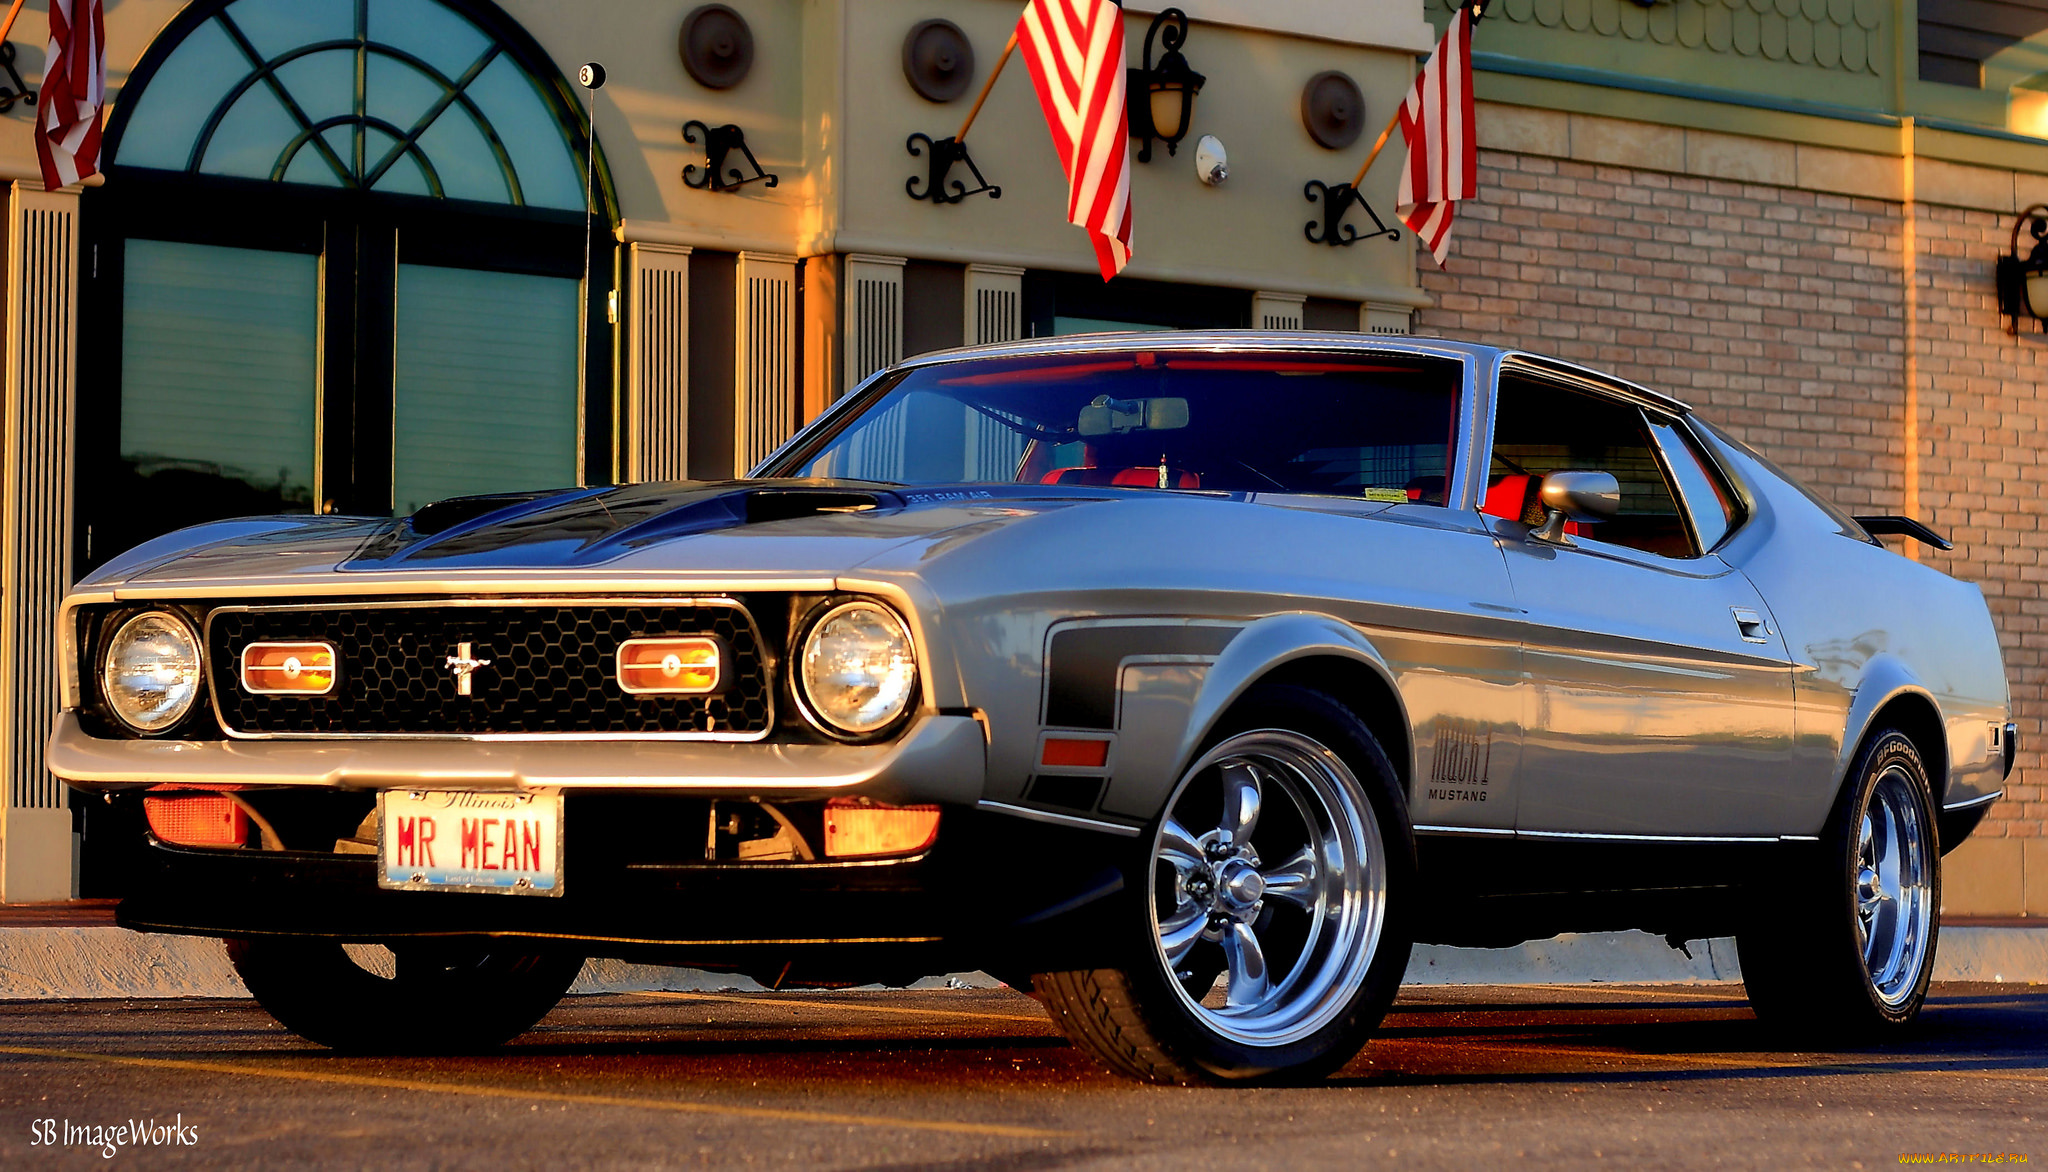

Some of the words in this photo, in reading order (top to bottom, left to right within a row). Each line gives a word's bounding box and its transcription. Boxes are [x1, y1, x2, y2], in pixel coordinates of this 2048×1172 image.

[581, 68, 589, 82] 8
[935, 492, 968, 501] RAM
[440, 791, 515, 809] Illinois
[1428, 789, 1488, 801] MUSTANG
[398, 816, 436, 867] MR
[461, 818, 541, 871] MEAN
